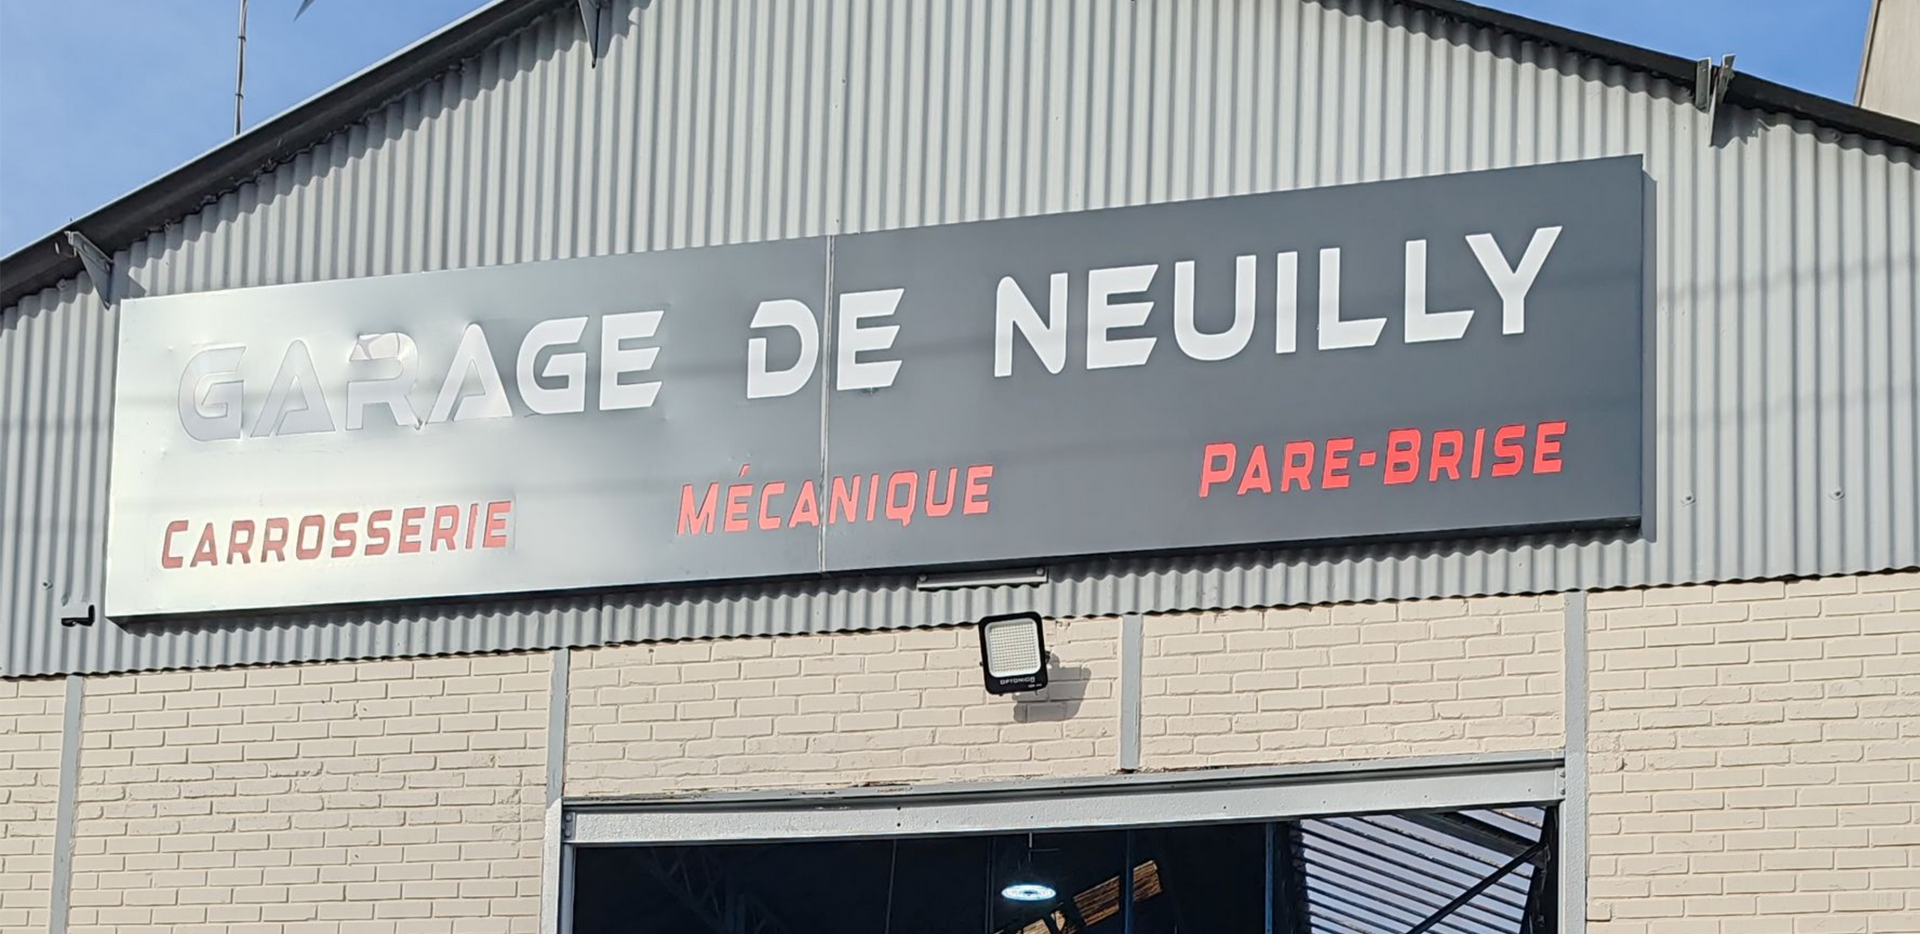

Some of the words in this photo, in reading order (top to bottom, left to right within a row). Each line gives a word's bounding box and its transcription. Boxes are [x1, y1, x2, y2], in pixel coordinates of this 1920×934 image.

[177, 309, 665, 442] GARAGE
[746, 287, 905, 399] DE
[994, 225, 1563, 378] NEUILLY
[161, 500, 513, 569] CARROSSERIE
[676, 463, 994, 536] MÉCANIQUE
[1199, 421, 1568, 498] PARE-BRISE
